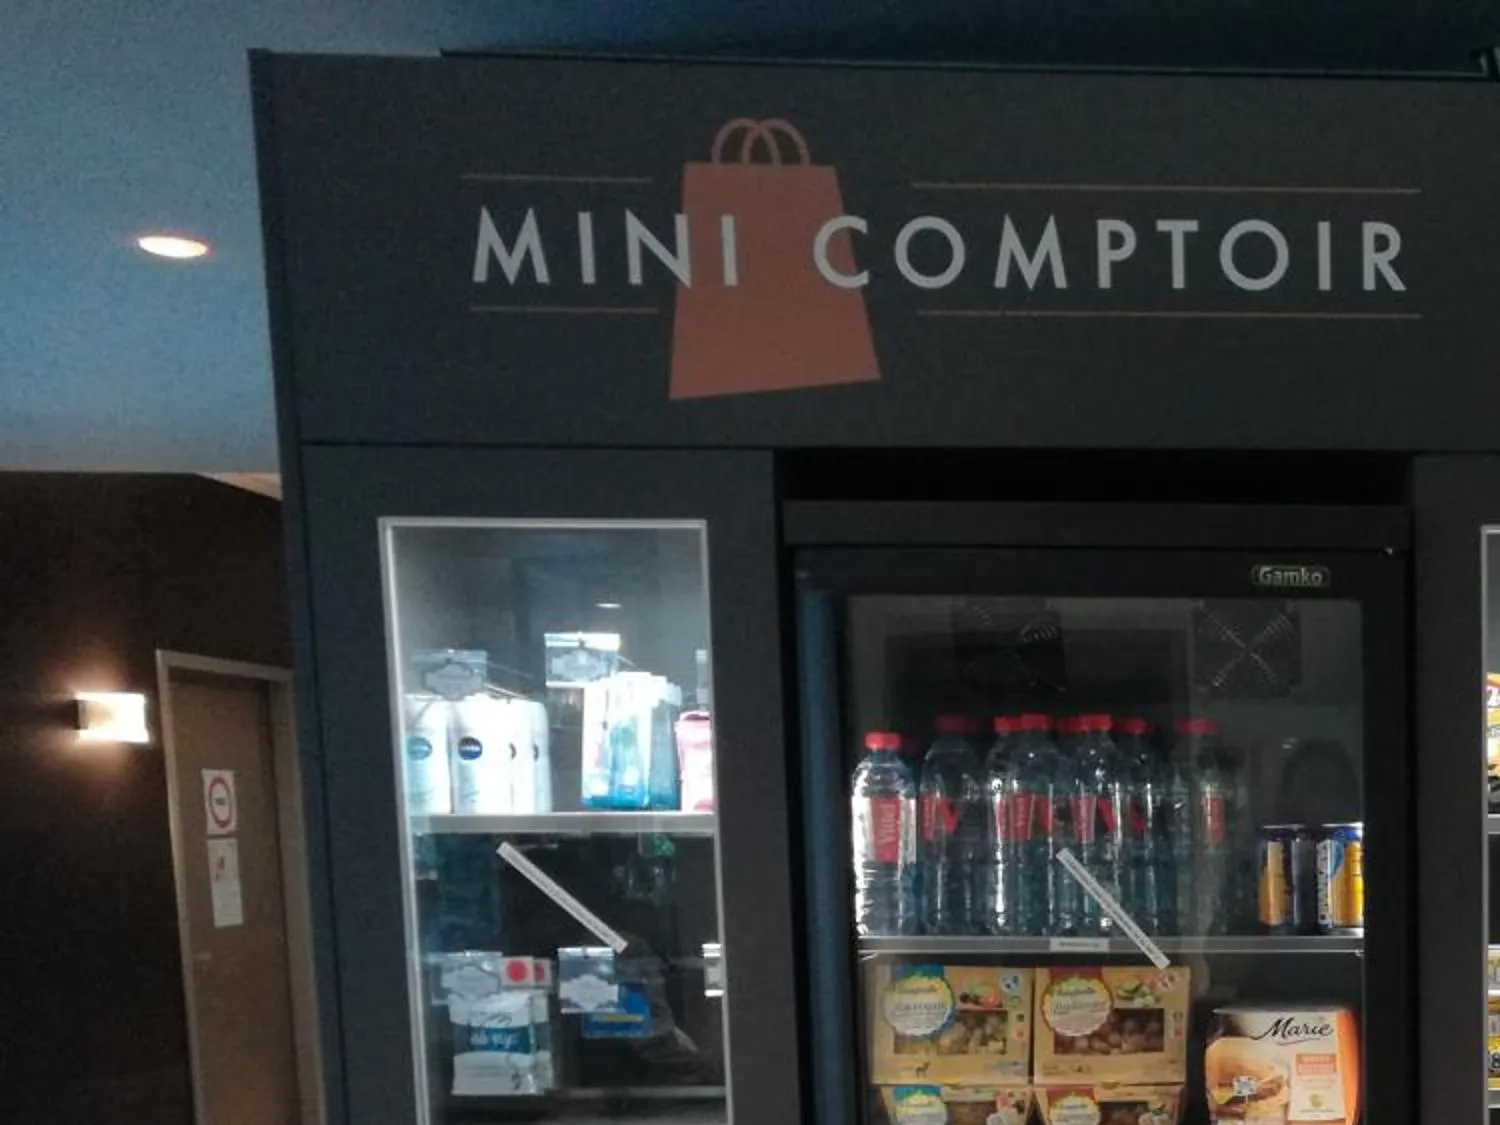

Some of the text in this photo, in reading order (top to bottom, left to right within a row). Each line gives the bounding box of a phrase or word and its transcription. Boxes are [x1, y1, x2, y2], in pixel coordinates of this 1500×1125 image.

[471, 206, 1408, 292] MINI COMPTOIR
[1250, 1016, 1334, 1041] Marie
